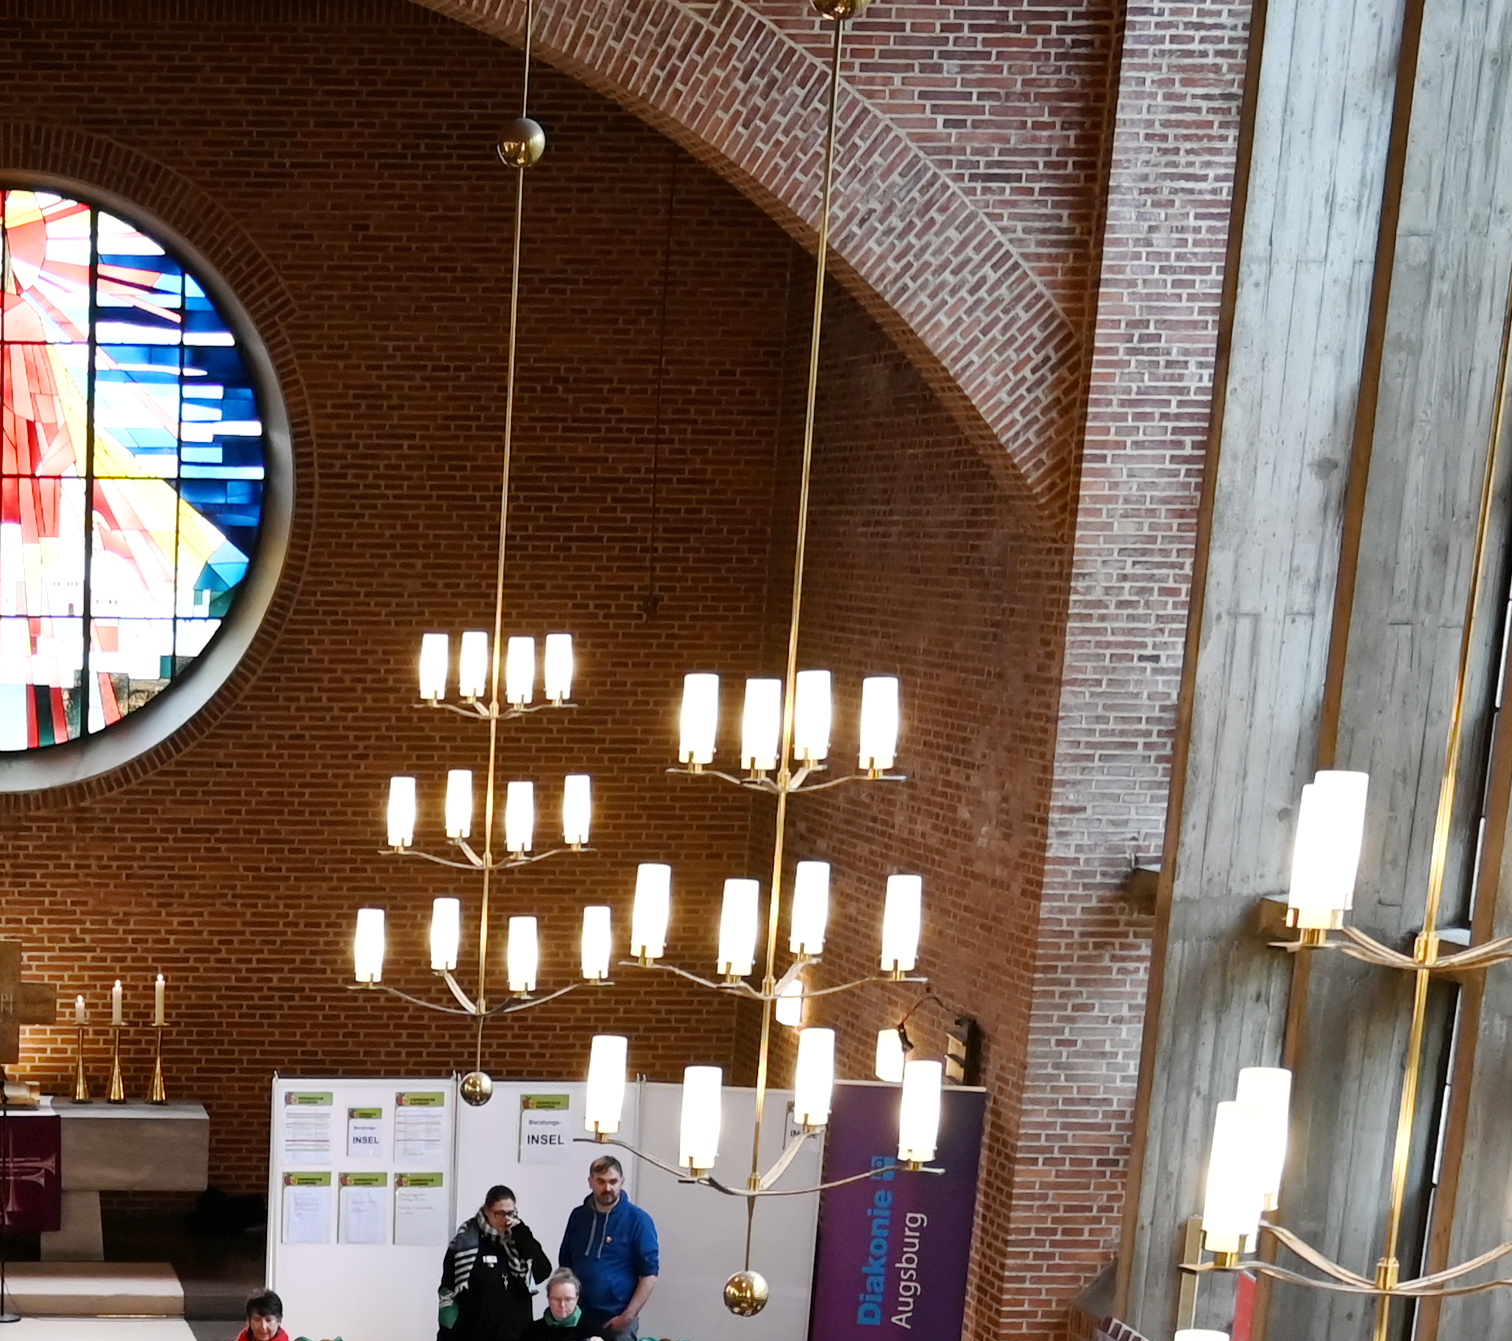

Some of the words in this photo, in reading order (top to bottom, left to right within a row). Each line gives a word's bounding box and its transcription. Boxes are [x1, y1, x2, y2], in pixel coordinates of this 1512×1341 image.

[352, 1136, 379, 1145] INSEL
[527, 1134, 564, 1145] INSEL
[857, 1190, 894, 1326] Diakonie
[891, 1212, 928, 1330] Augsburg
